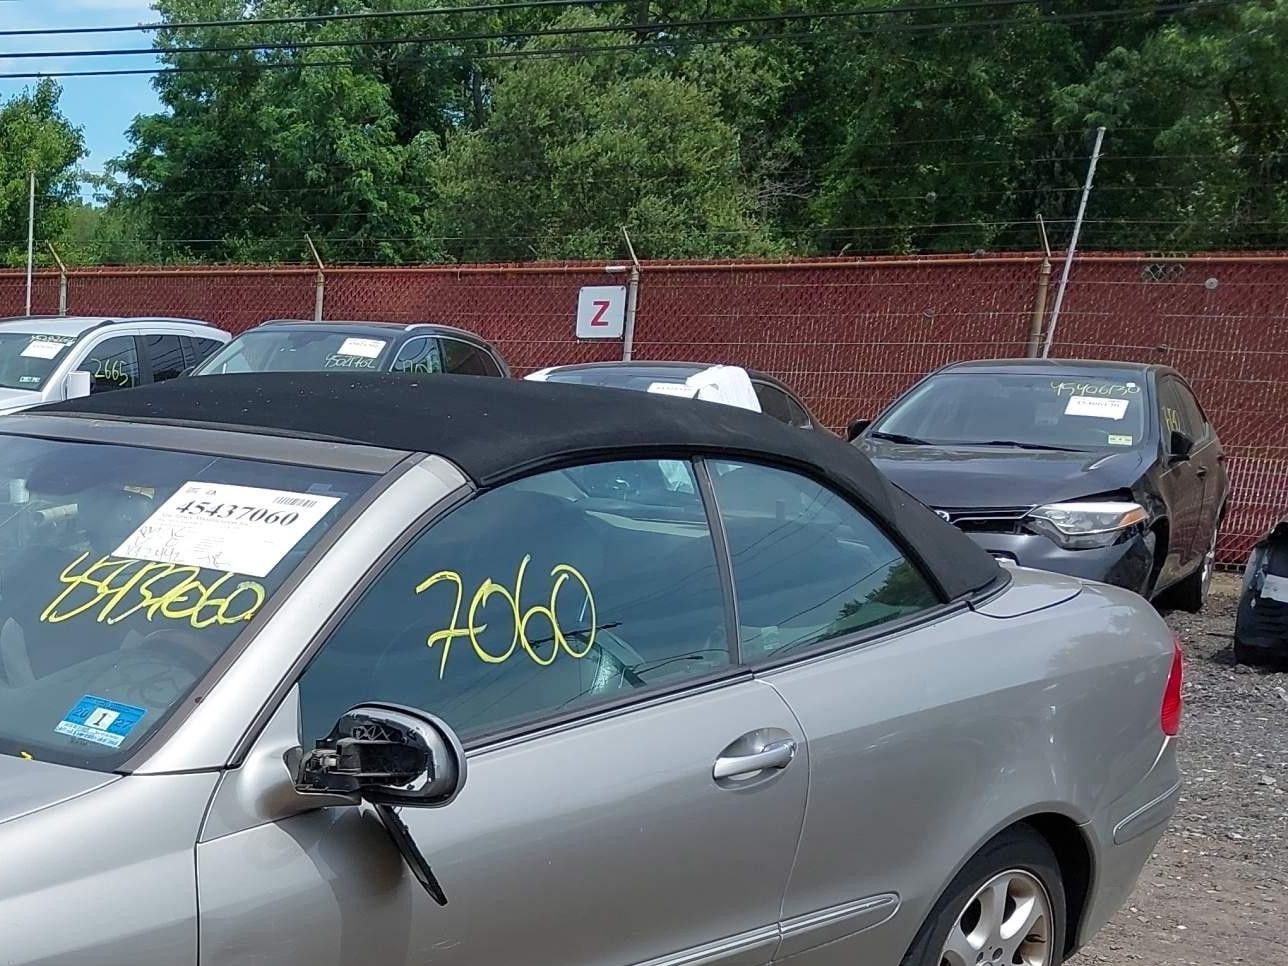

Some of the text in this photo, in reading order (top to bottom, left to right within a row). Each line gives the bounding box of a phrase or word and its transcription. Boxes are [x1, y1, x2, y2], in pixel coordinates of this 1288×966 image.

[591, 301, 610, 326] Z
[91, 358, 129, 386] 2665
[175, 499, 300, 527] 45437060
[416, 553, 596, 680] 7060
[93, 712, 108, 726] 1
